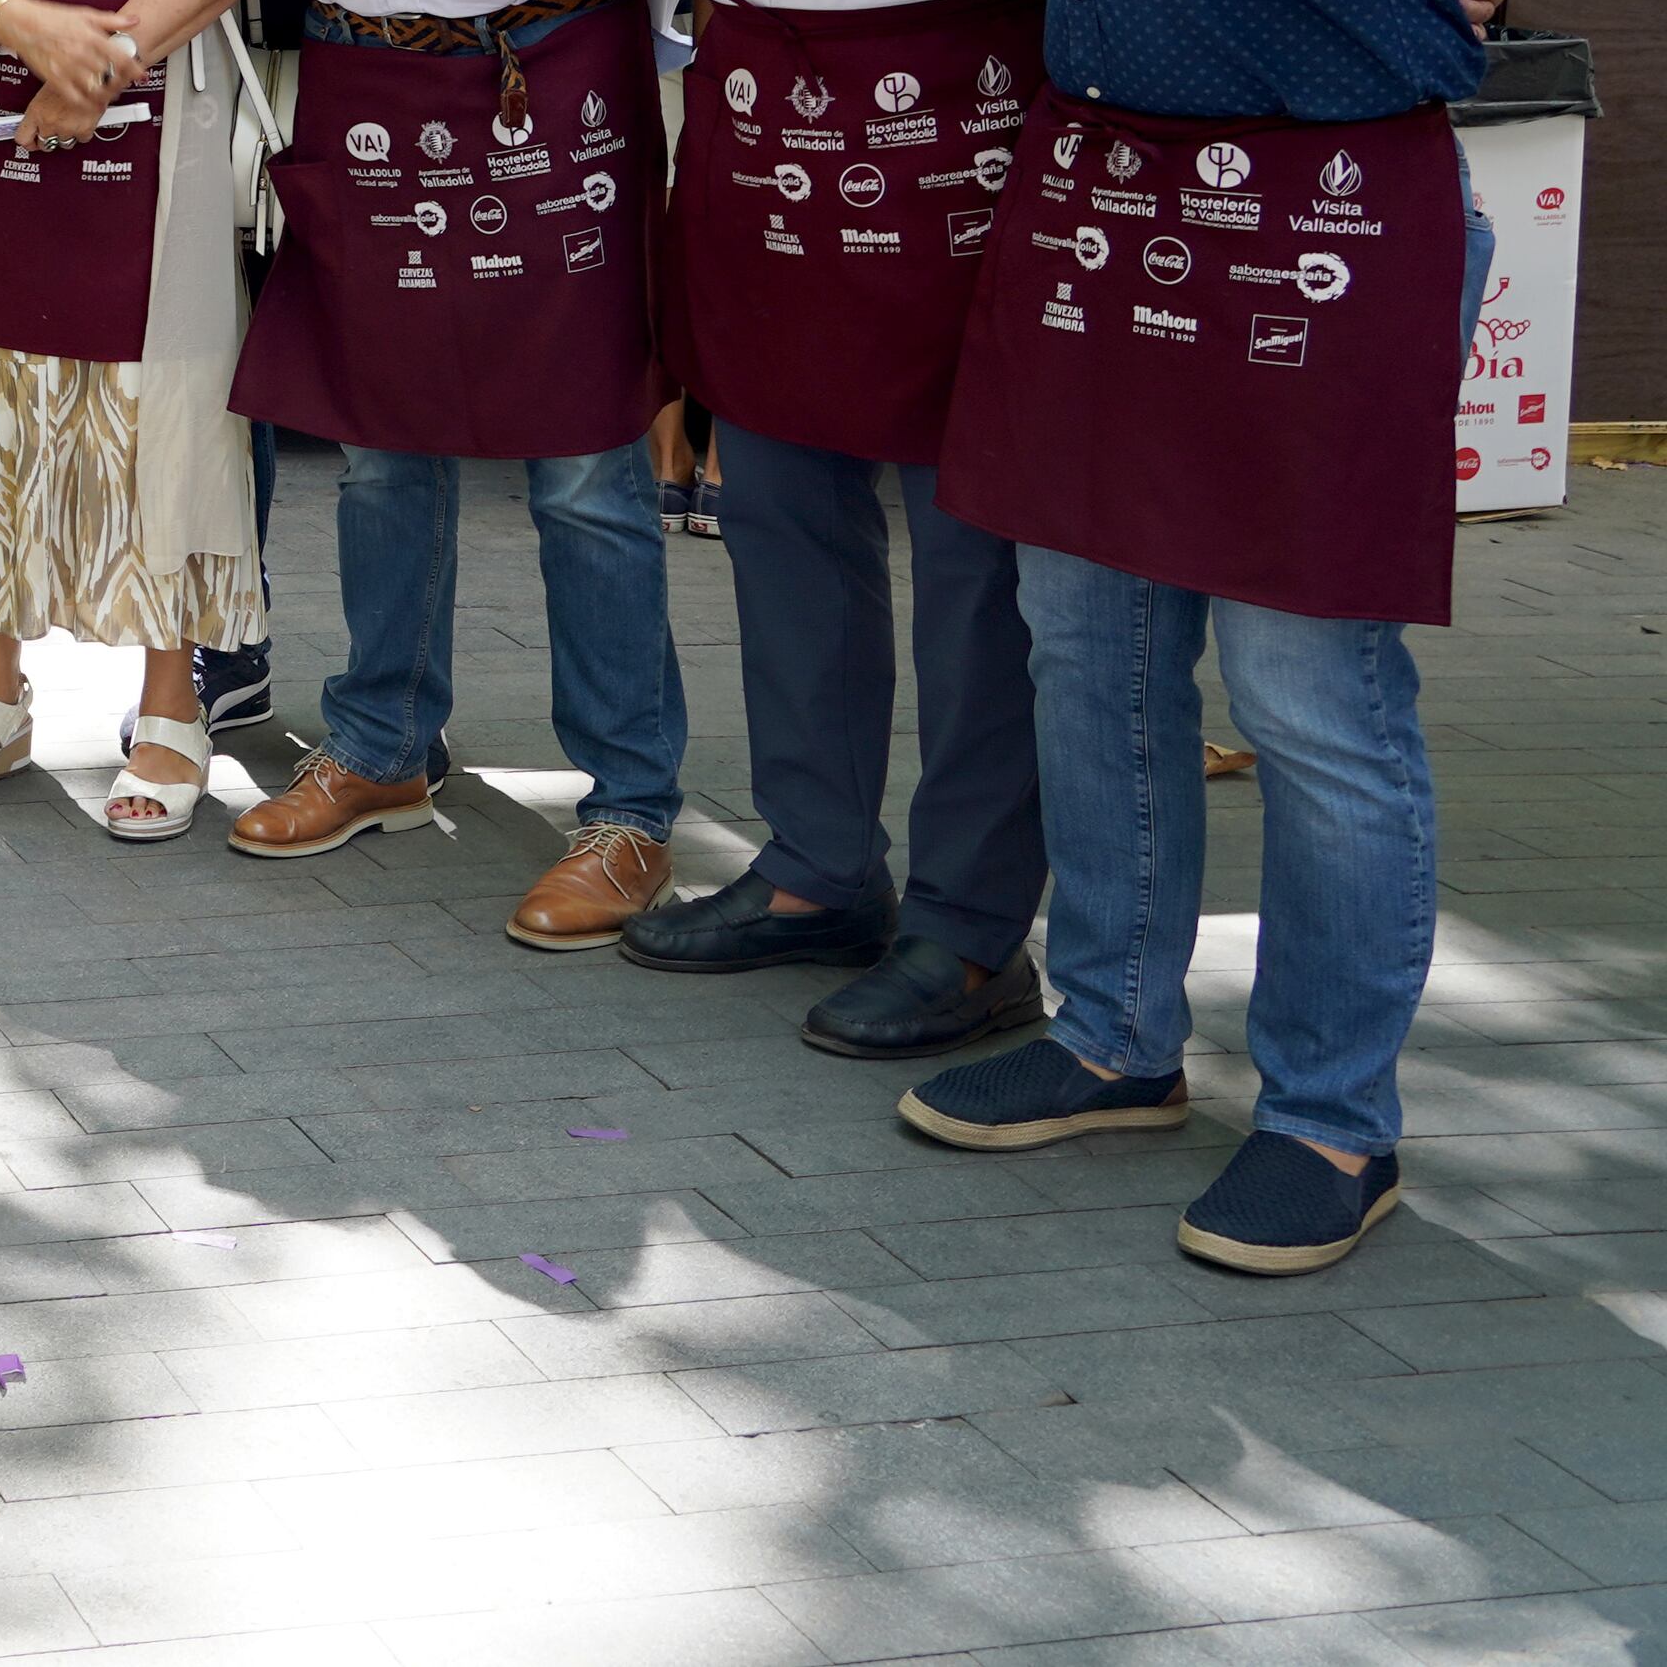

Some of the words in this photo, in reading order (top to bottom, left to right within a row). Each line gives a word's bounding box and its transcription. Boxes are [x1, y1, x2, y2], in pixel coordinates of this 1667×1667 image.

[729, 78, 751, 105] VA!
[976, 98, 1019, 116] Visita
[781, 127, 832, 138] Ayuntamiento
[866, 115, 936, 136] Hostelería
[349, 134, 385, 153] VA!
[581, 128, 612, 146] Visita
[782, 137, 845, 151] Valladolid
[867, 134, 883, 145] de
[884, 126, 938, 142] Valladolid
[487, 149, 549, 169] Hostelería
[569, 137, 626, 164] Valladolid
[4, 159, 40, 173] CERVEZAS
[82, 159, 132, 173] Mahou
[348, 168, 402, 178] VALLADOLID
[490, 168, 503, 178] de
[503, 159, 551, 175] Valladolid
[0, 169, 41, 183] ALHAMBRA
[419, 174, 474, 188] Valladolid
[1091, 186, 1143, 201] Ayuntamiento
[1144, 193, 1158, 203] de
[1539, 193, 1561, 206] VA!
[1091, 196, 1156, 219] Valladolid
[1179, 193, 1261, 215] Hostelería
[1312, 199, 1363, 217] Visita
[1181, 206, 1197, 218] de
[1198, 210, 1260, 225] Valladolid
[1289, 215, 1382, 236] Valladolid
[840, 228, 900, 245] Mahou
[470, 254, 523, 271] Mahou
[1147, 251, 1185, 271] Coca-Cola
[398, 268, 434, 279] CERVEZAS
[398, 277, 437, 288] ALHAMBRA
[1045, 300, 1084, 320] CERVEZAS
[1133, 304, 1198, 332] Mahou
[1041, 315, 1085, 334] ALHAMBRA
[1132, 325, 1167, 338] DESDE
[1170, 330, 1196, 343] 1890
[1459, 401, 1495, 415] ahou
